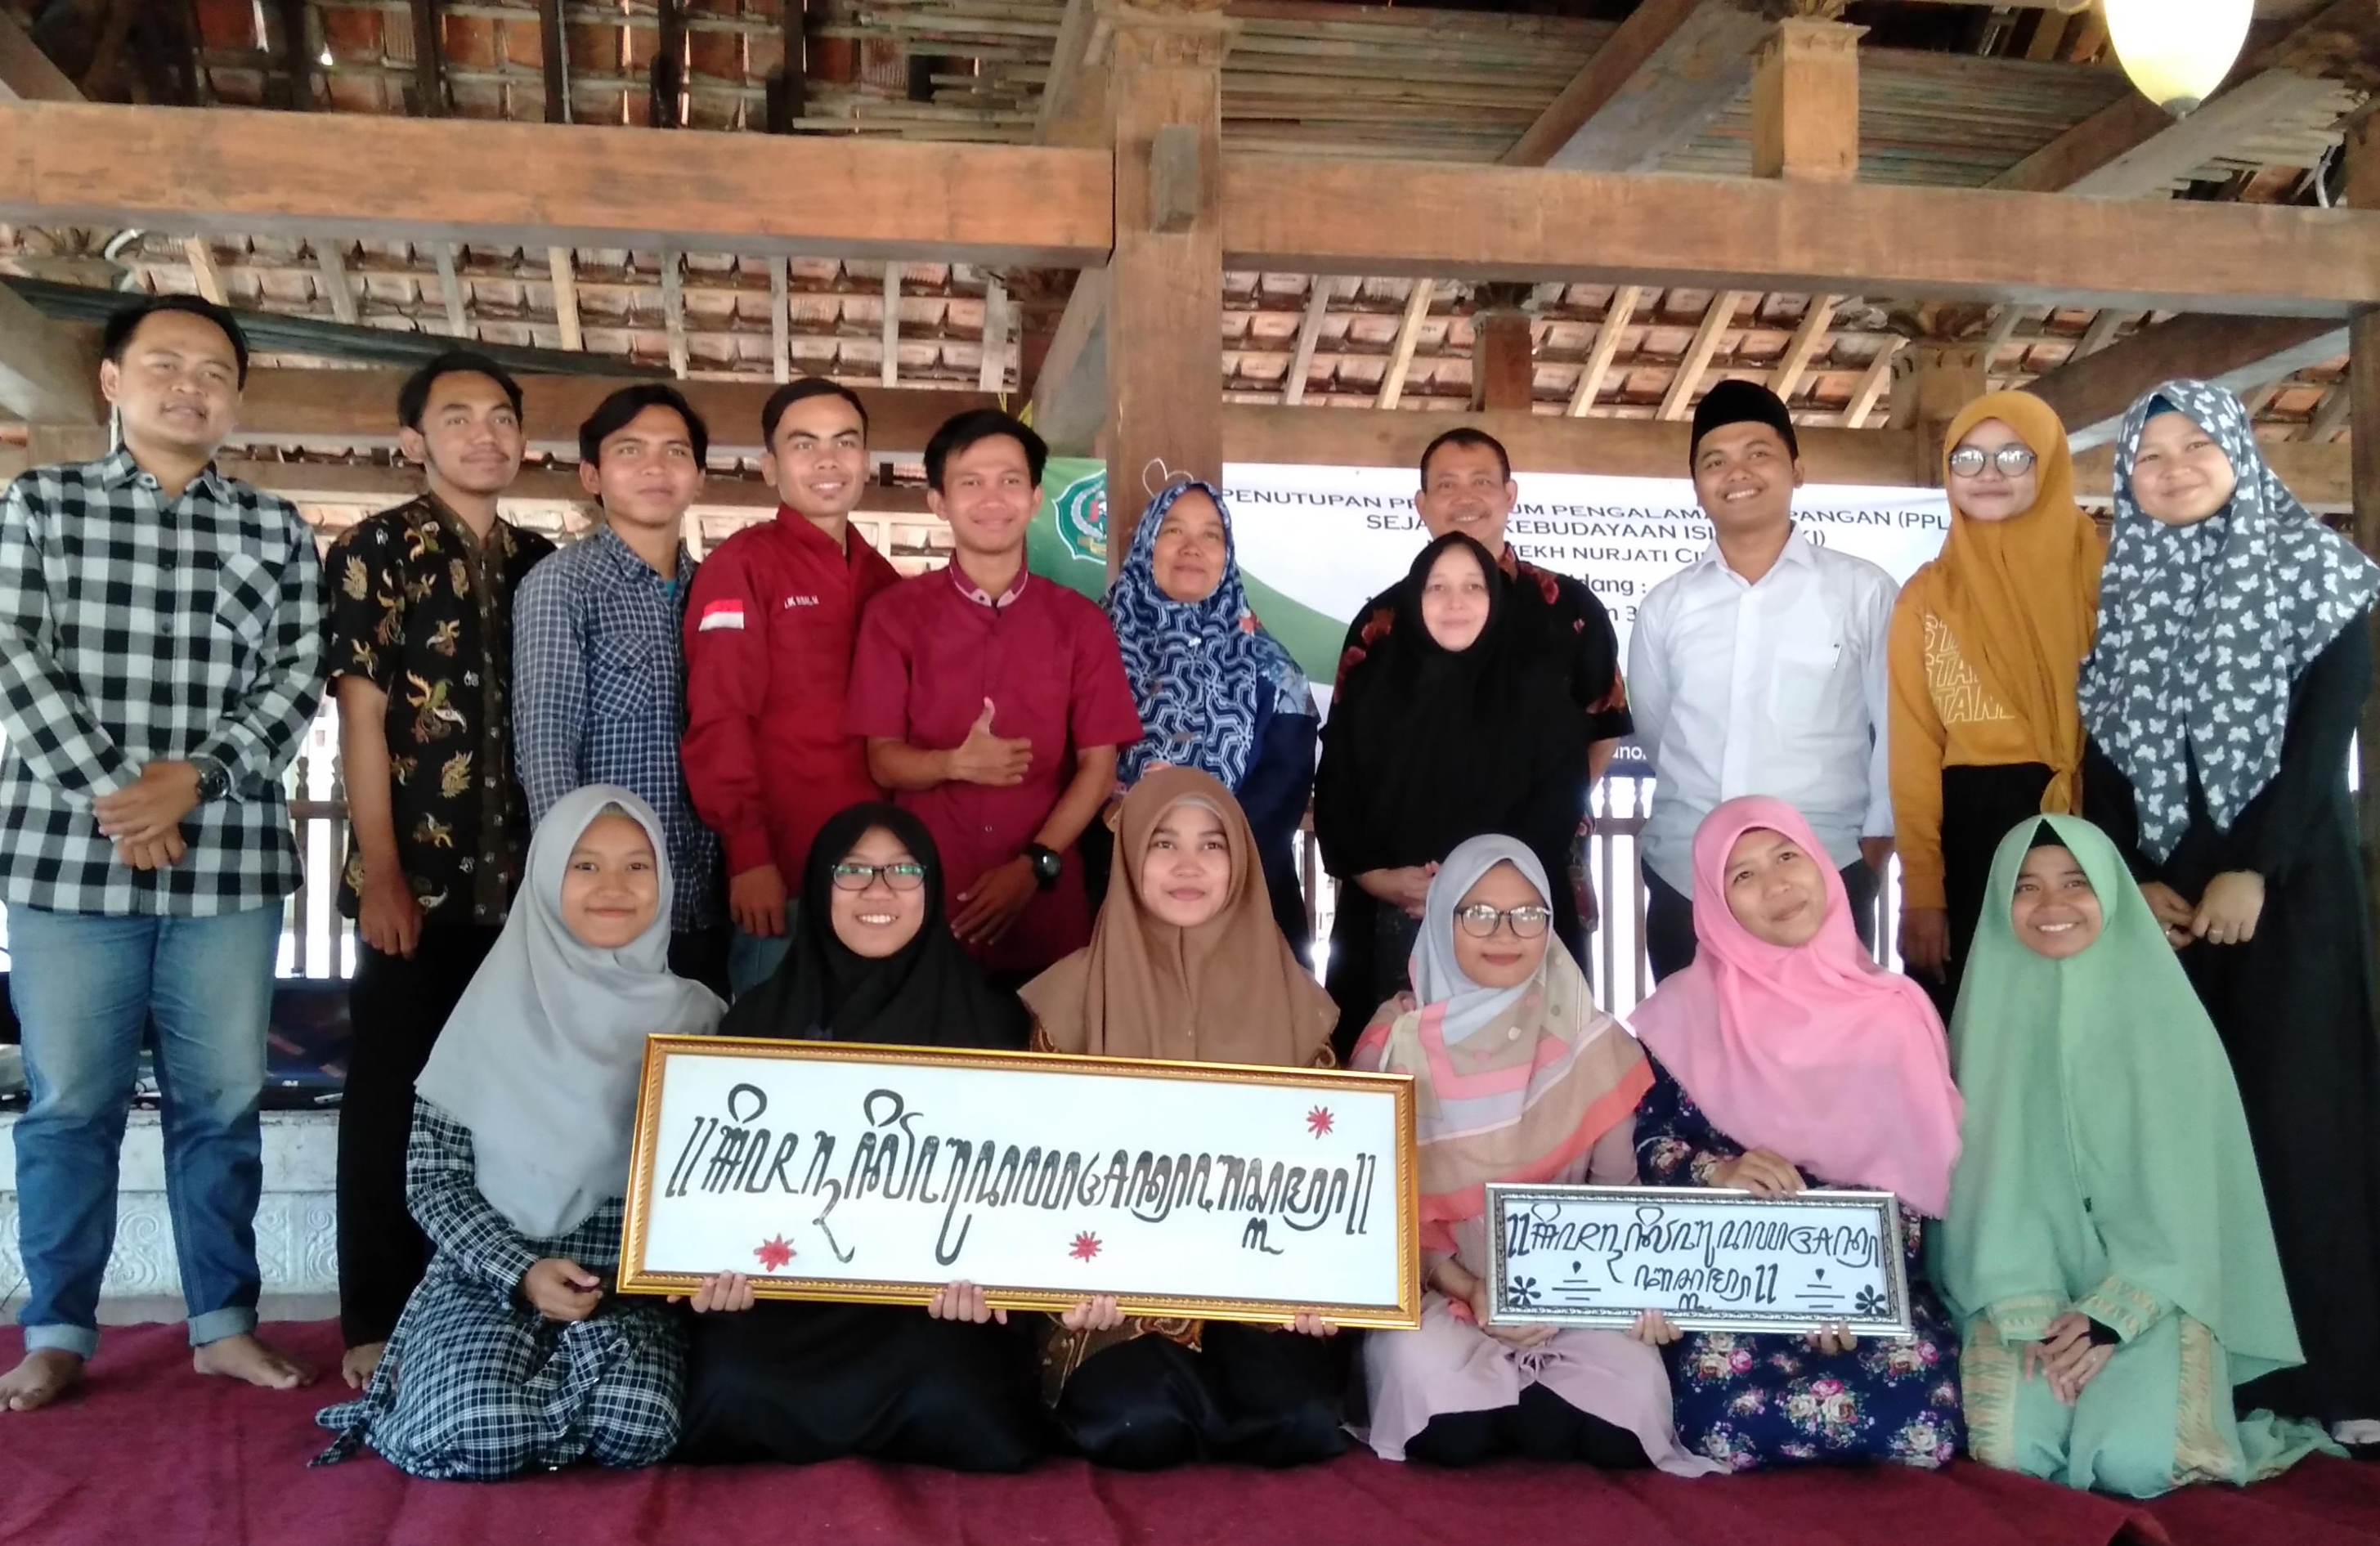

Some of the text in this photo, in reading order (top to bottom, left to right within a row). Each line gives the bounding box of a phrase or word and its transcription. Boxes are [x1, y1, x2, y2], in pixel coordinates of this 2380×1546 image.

[1222, 489, 1382, 509] PENUTUPAN
[1553, 505, 1709, 519] PENGALAM
[1573, 547, 1668, 562] NURJATI
